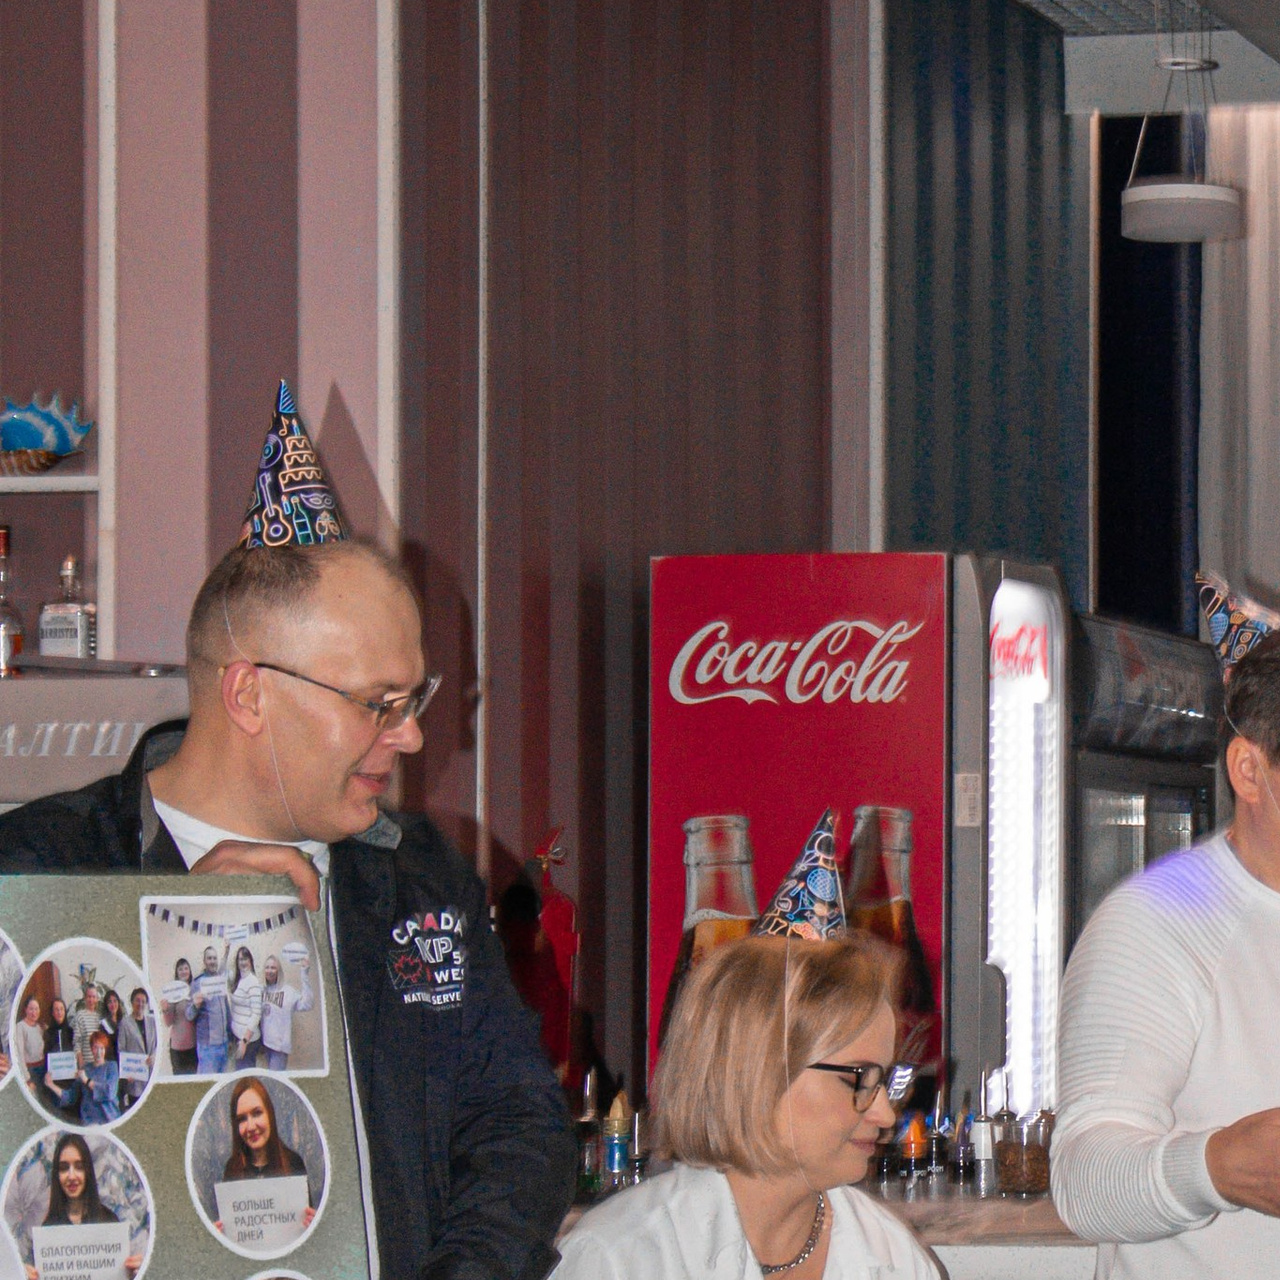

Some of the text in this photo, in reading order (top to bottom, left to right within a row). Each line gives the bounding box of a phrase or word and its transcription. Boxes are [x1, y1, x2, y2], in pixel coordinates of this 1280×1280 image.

[668, 620, 925, 705] Coca-Cola
[392, 912, 463, 945] CAADA
[232, 1198, 275, 1212] БОЛЬШЕ
[234, 1212, 297, 1227] РАДОСТНЫХ
[40, 1243, 122, 1258] БЛАГОПОЛУЧИЯ
[42, 1258, 116, 1272] ВАМ И ВАШИМ
